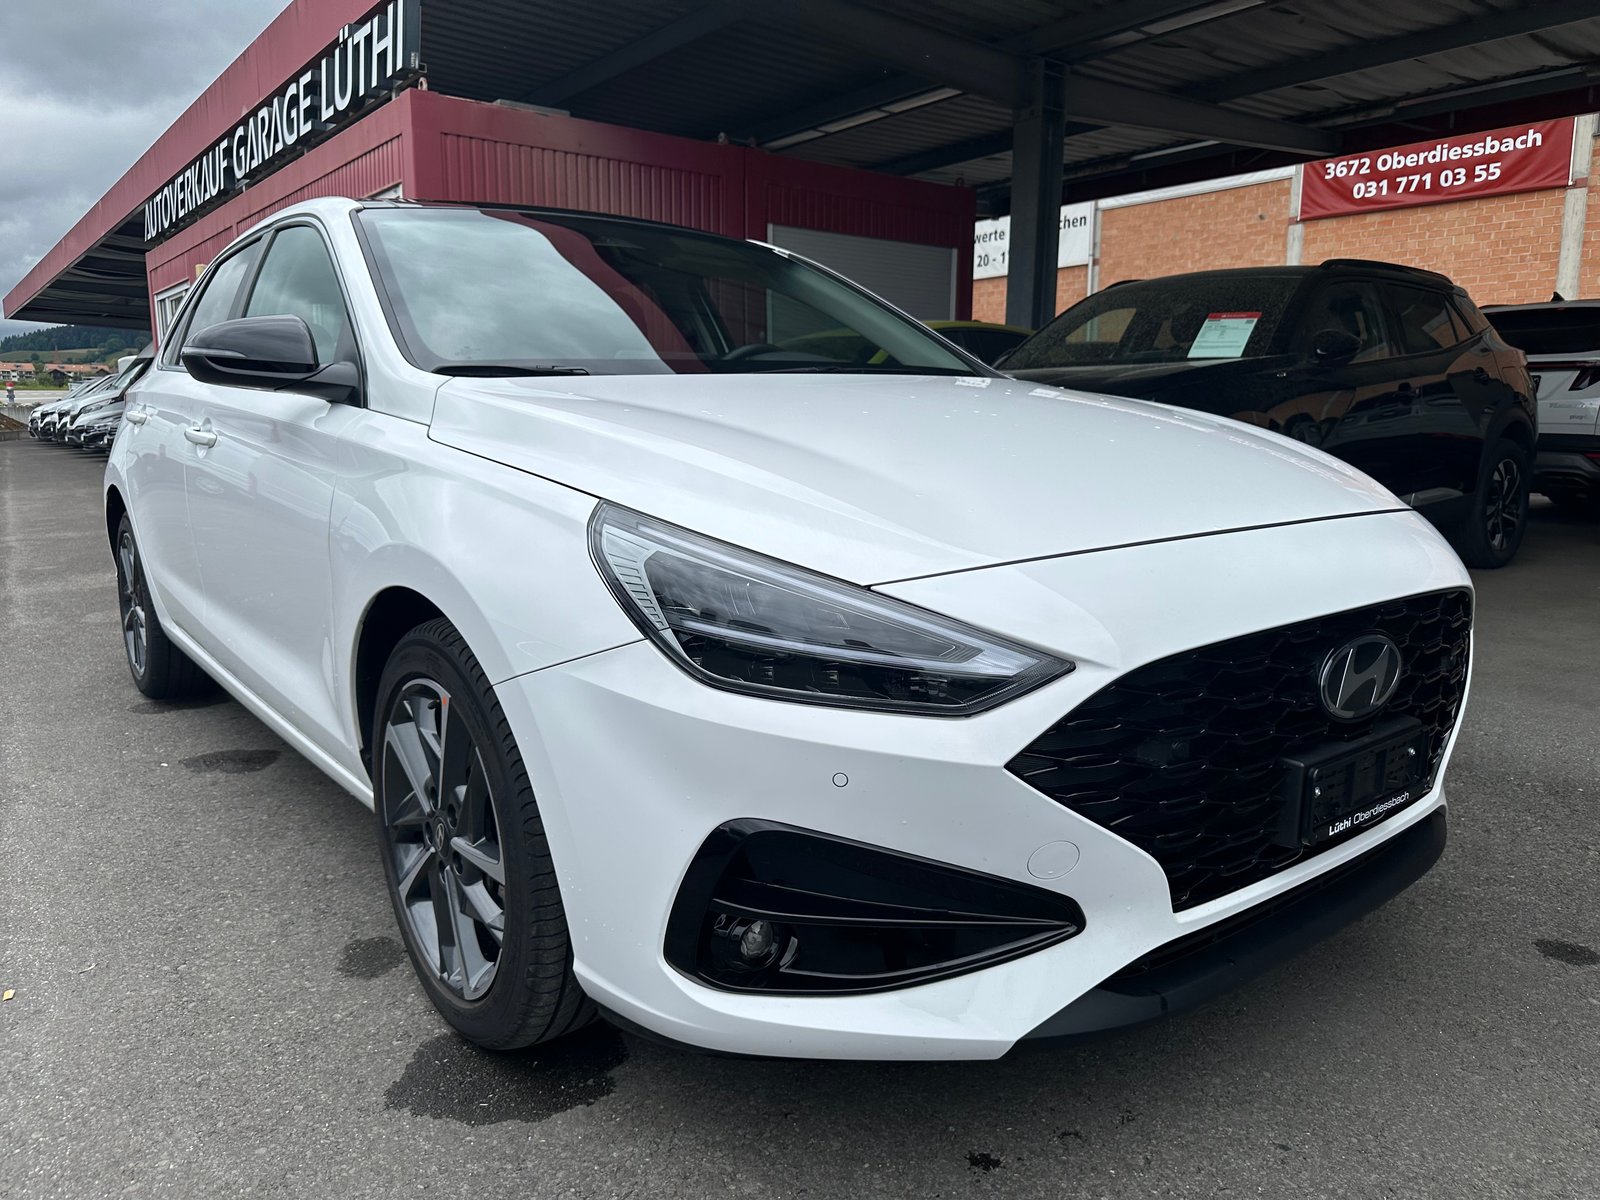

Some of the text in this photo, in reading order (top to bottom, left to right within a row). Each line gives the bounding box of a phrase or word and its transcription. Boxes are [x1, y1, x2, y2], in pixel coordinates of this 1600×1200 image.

[144, 0, 404, 242] AUTOVERKAUF GARAGE LÜTHI
[1324, 129, 1543, 180] 3672 Oberdiessbach
[1352, 162, 1502, 199] 031 771 03 55
[977, 254, 989, 267] 20
[1328, 791, 1410, 836] Lüthi Oberdiessbach
